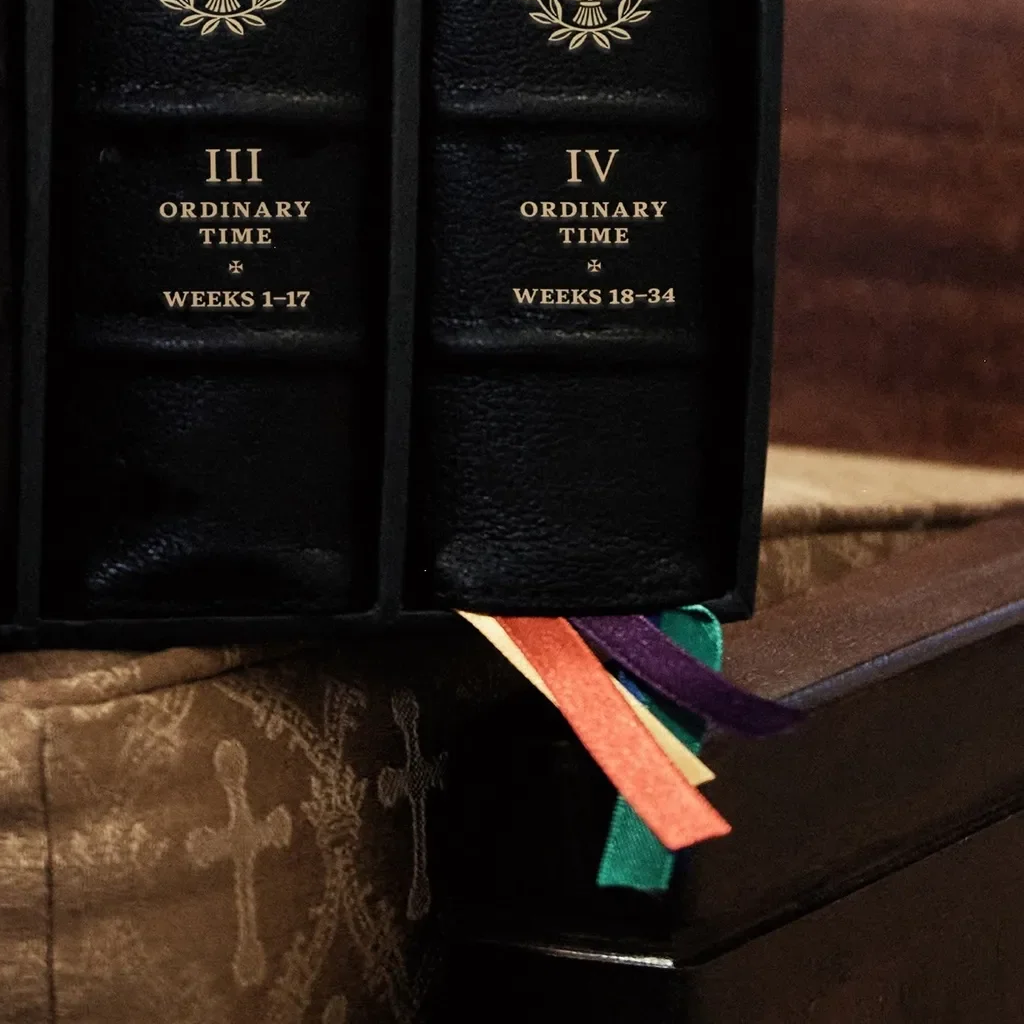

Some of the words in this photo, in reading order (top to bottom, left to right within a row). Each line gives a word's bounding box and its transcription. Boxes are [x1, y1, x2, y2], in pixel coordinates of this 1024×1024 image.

[205, 148, 263, 183] III
[565, 148, 620, 183] IV
[159, 200, 311, 219] ORDINARY
[520, 201, 668, 218] ORDINARY
[198, 227, 272, 245] TIME
[558, 227, 629, 244] TIME
[162, 290, 255, 308] WEEKS
[512, 287, 602, 305] WEEKS
